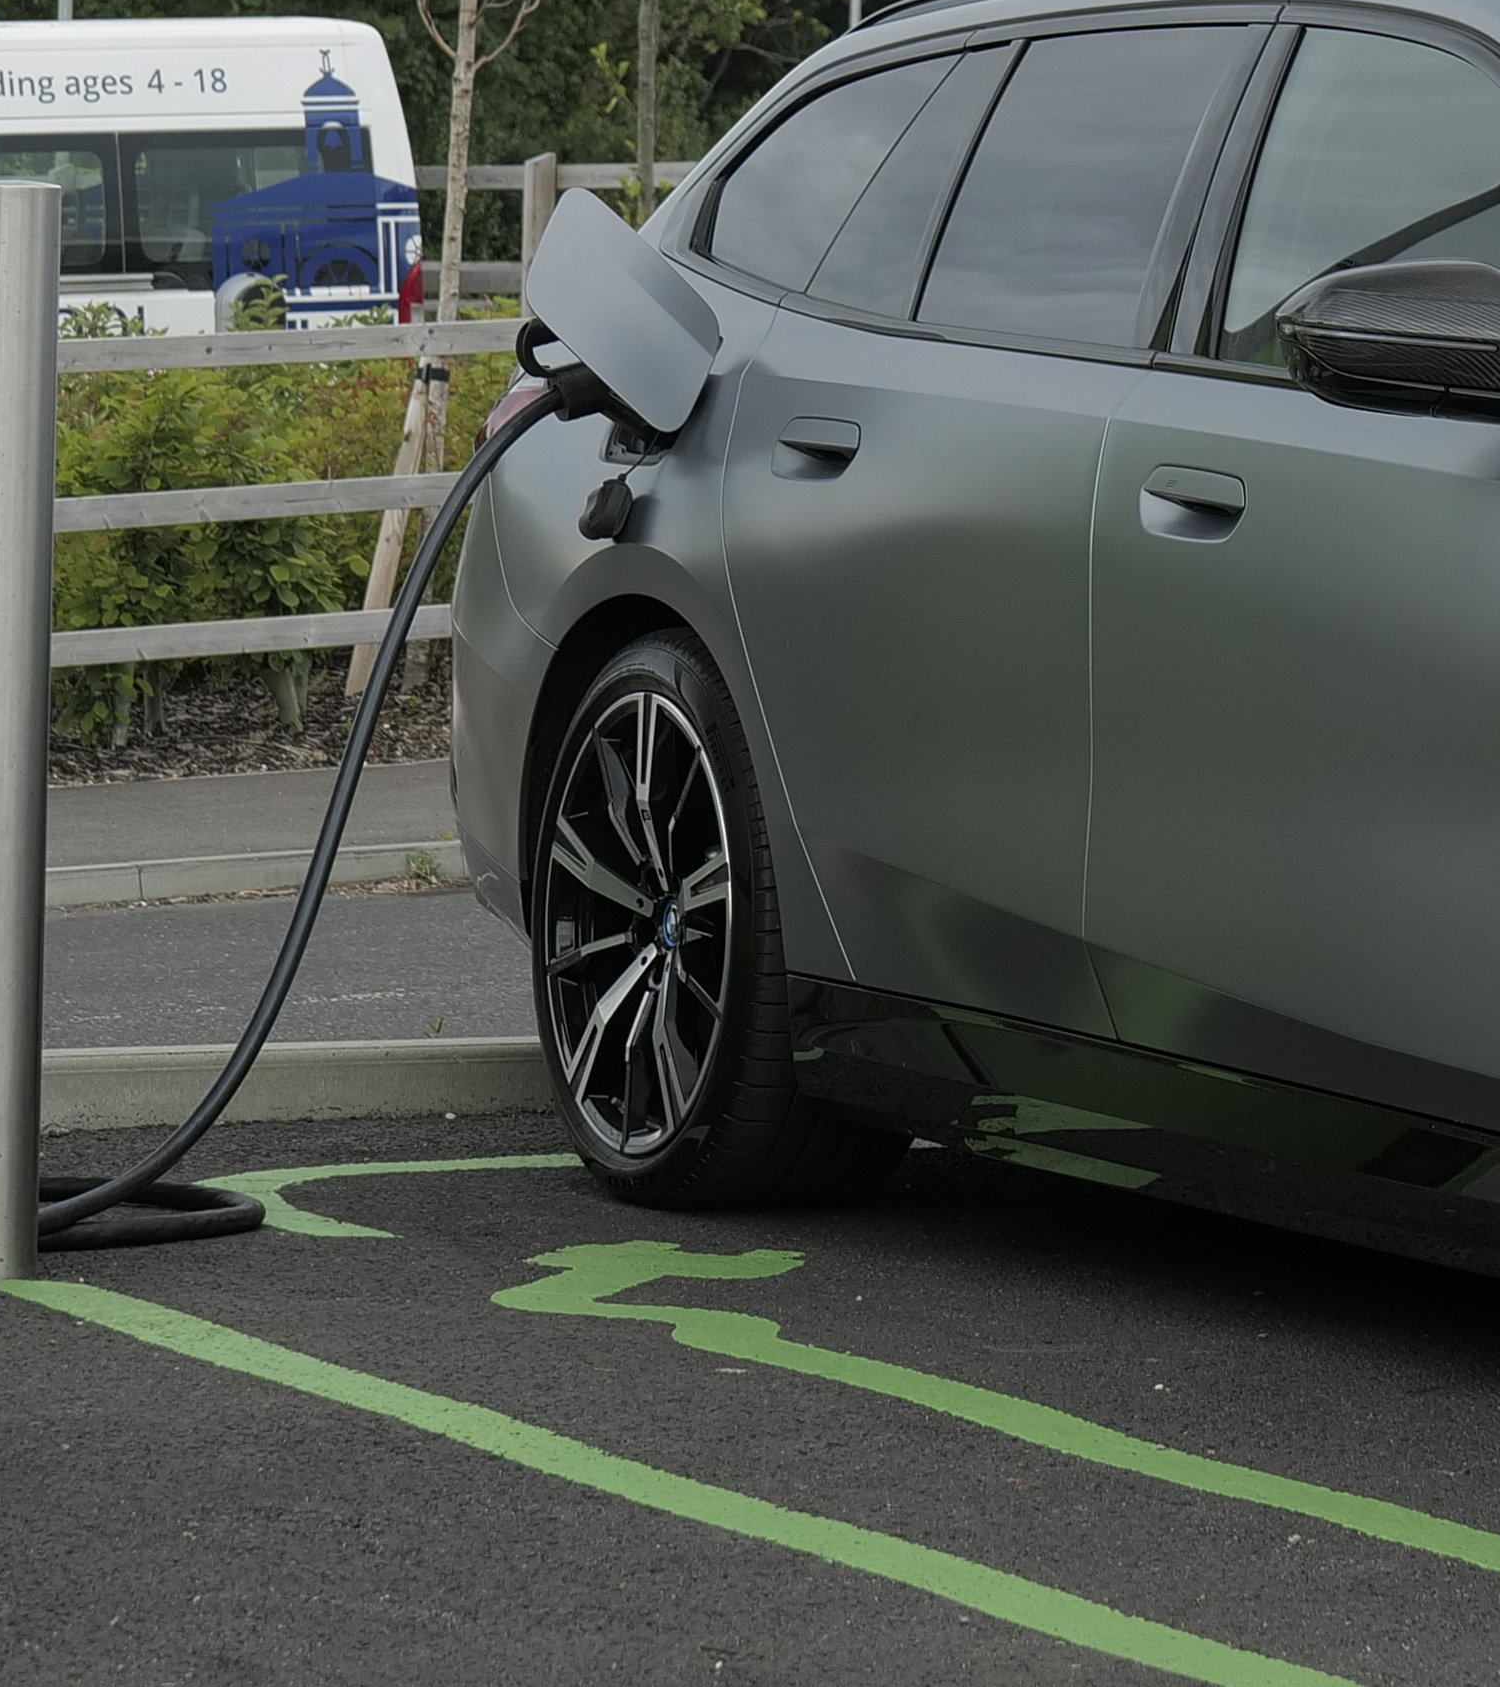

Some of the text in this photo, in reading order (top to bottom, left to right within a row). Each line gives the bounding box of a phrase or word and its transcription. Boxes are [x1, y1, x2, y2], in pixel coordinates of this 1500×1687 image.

[64, 71, 134, 104] ages
[147, 68, 165, 95] 4
[193, 67, 229, 95] 18
